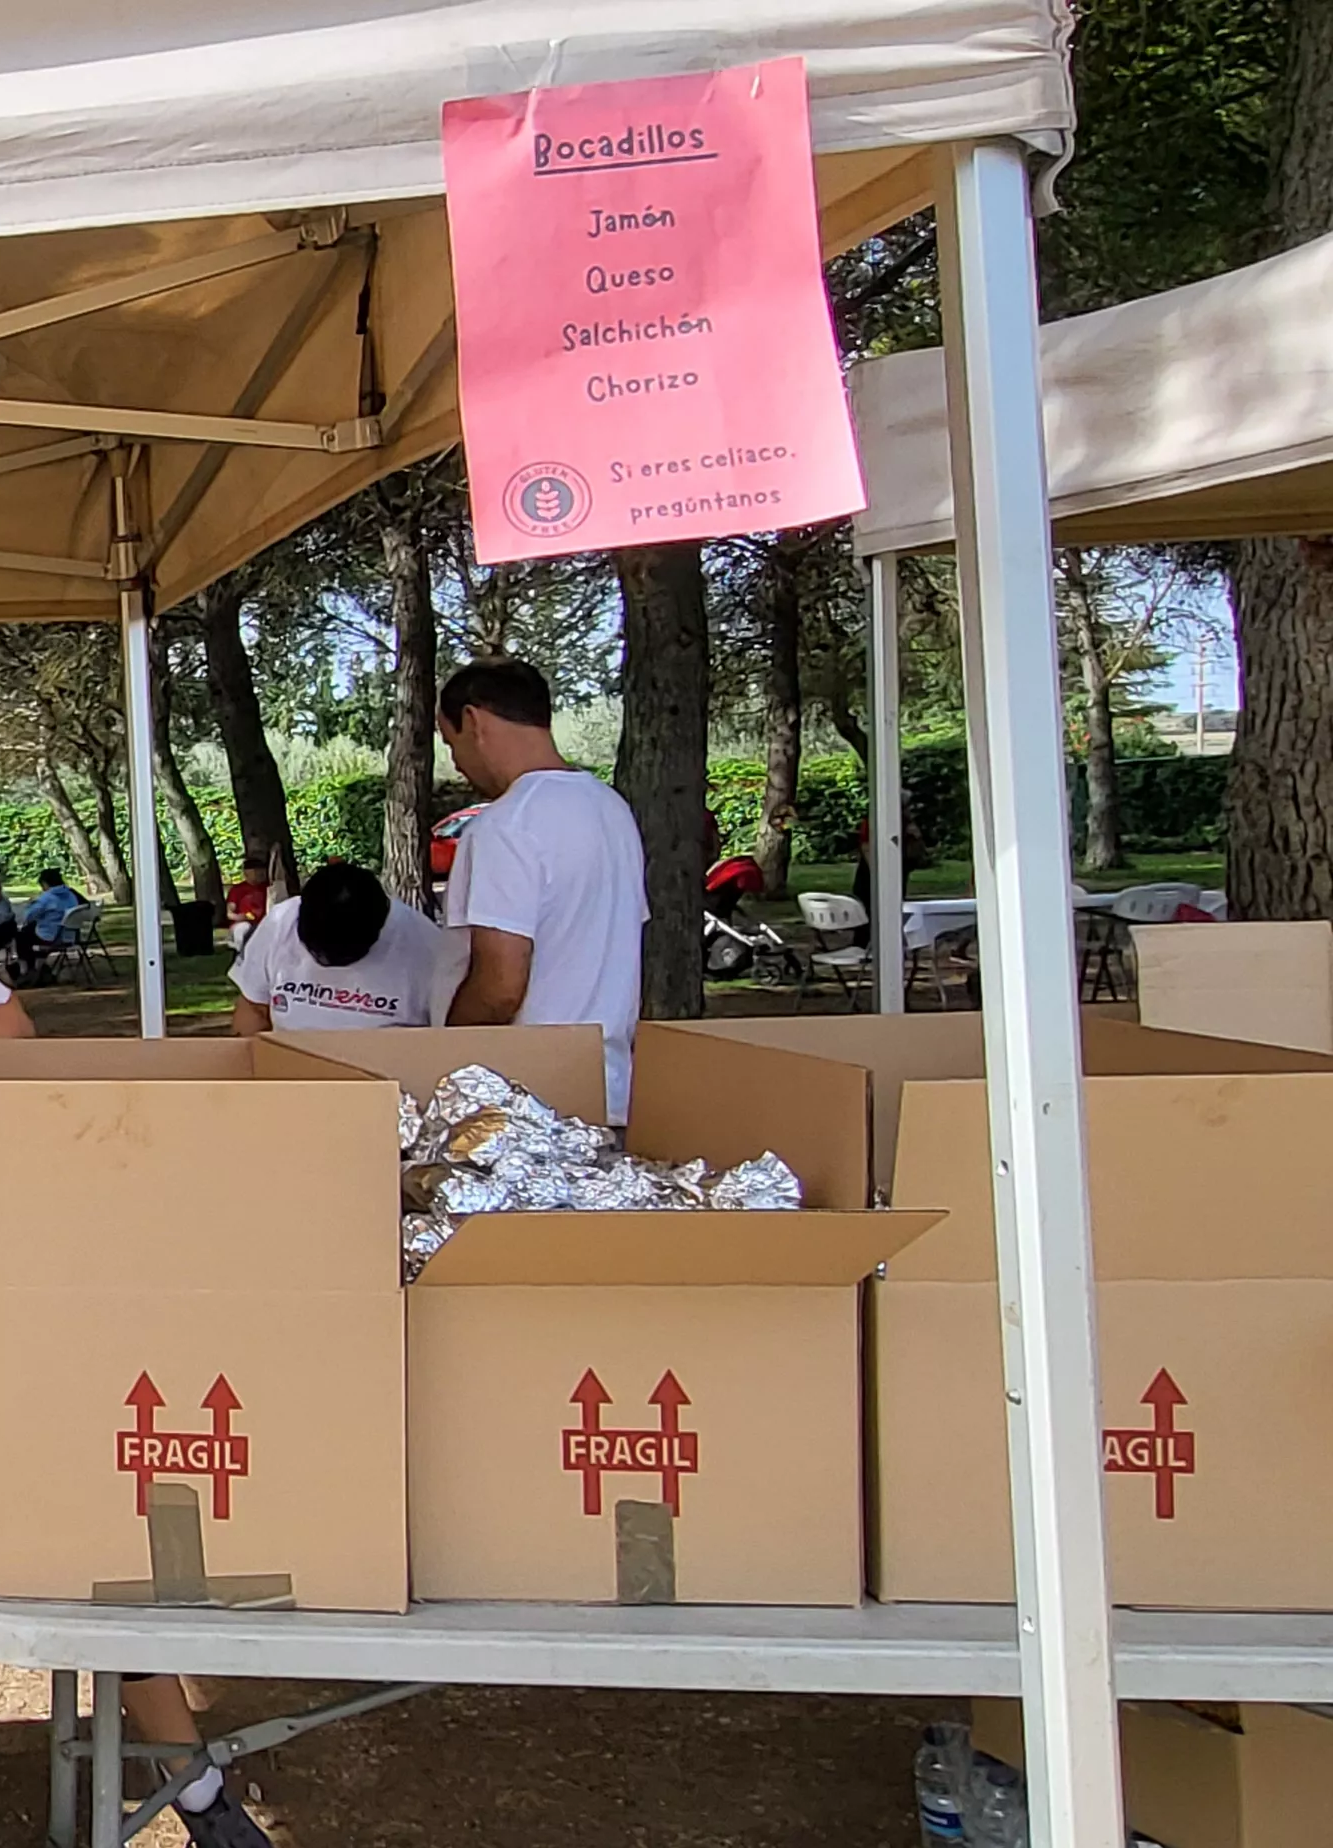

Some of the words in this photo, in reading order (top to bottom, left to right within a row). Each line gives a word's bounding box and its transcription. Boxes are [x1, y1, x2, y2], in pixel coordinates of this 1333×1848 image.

[534, 124, 705, 168] Bocadillos
[587, 206, 676, 240] Jamón
[585, 264, 675, 294] Queso
[562, 313, 713, 352] Salchichón
[586, 368, 699, 403] Chorizo
[610, 462, 633, 483] Si
[641, 456, 692, 477] eres
[630, 489, 782, 525] pregúntanos
[123, 1437, 242, 1470] FRAGIL
[568, 1435, 692, 1467] FRAGIL
[1104, 1436, 1187, 1467] AGIL
